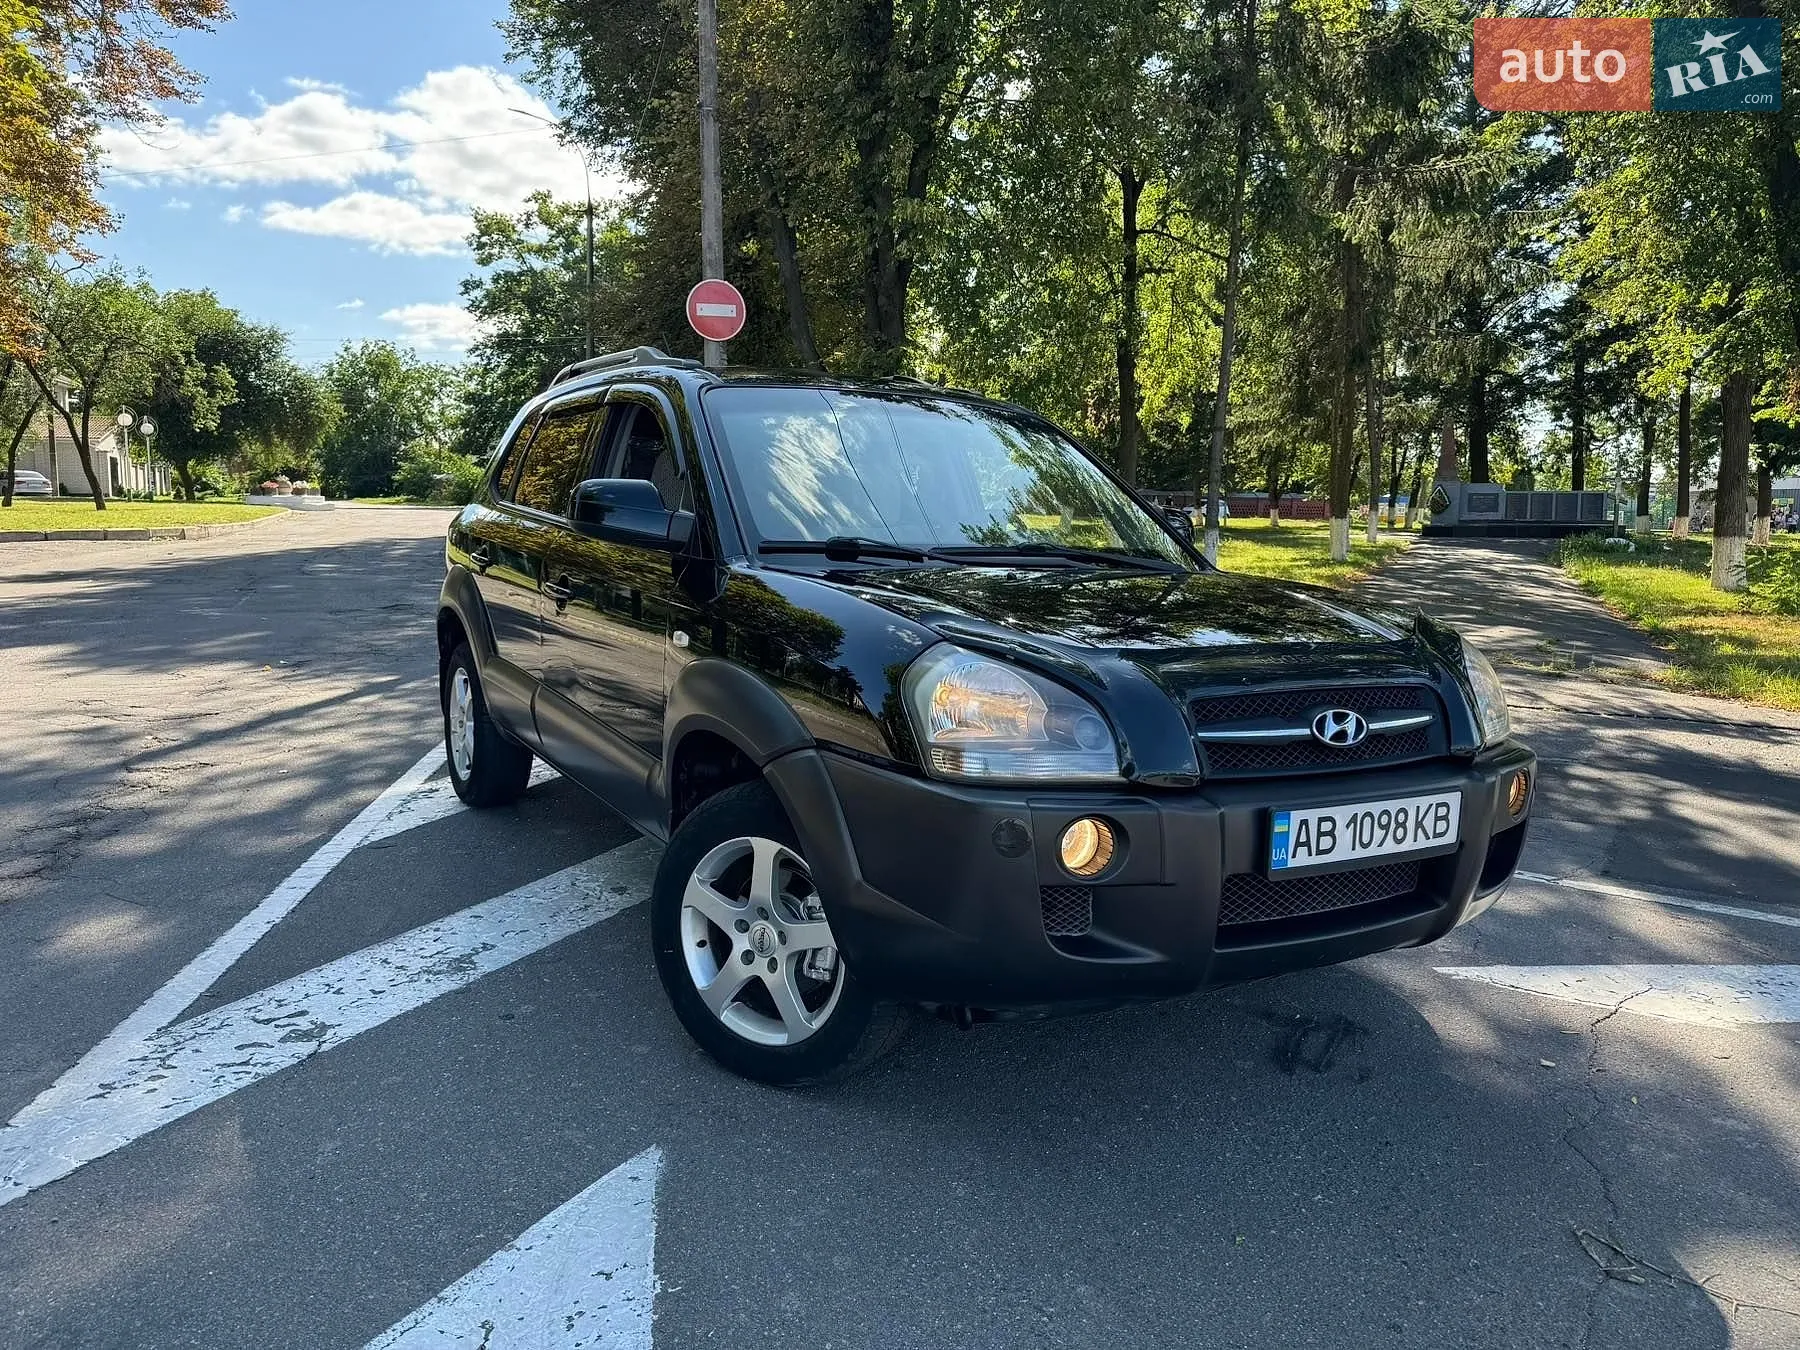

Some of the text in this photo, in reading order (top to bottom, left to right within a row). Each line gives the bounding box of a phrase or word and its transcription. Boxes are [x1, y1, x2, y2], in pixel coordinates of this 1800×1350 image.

[1291, 801, 1450, 859] AB 1098 KB
[1272, 848, 1287, 861] UA
